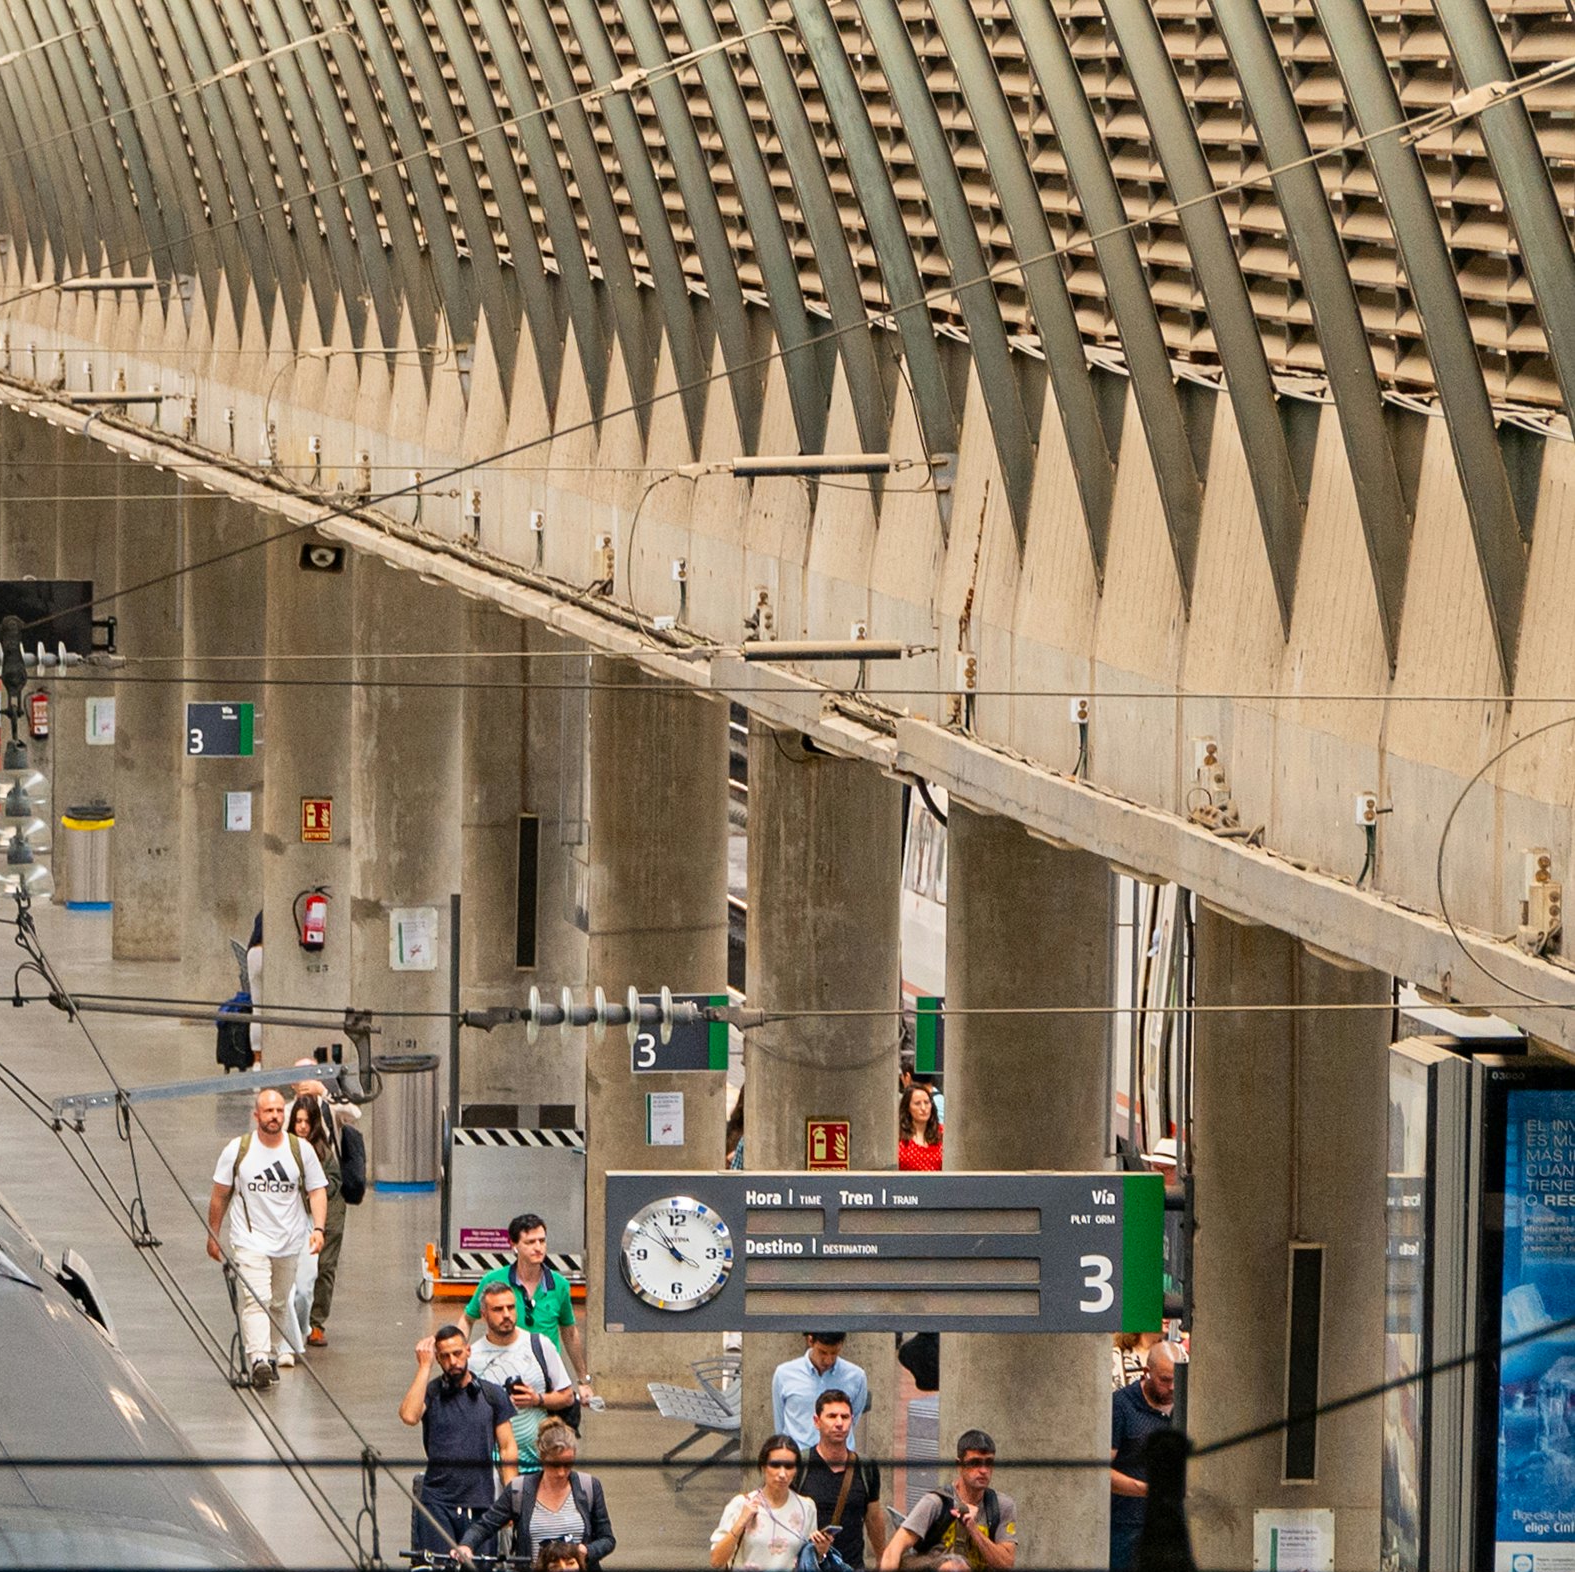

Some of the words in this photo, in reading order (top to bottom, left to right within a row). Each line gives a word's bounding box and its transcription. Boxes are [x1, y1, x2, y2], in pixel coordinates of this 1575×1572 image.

[189, 728, 204, 754] 3
[637, 1033, 657, 1068] 3
[1526, 1120, 1547, 1132] EL
[1526, 1134, 1548, 1147] ES
[247, 1180, 295, 1193] adidas
[745, 1190, 782, 1205] Hora
[799, 1195, 822, 1205] TIME
[839, 1190, 873, 1205] Tren
[892, 1195, 918, 1205] TRAIN
[1091, 1188, 1116, 1205] Vía
[668, 1214, 686, 1227] 12
[745, 1239, 803, 1254] Destino
[823, 1244, 878, 1254] DESTINATION
[636, 1249, 647, 1261] 9
[705, 1248, 717, 1260] 3
[671, 1282, 683, 1294] 6
[1079, 1254, 1115, 1313] 3
[1525, 1522, 1550, 1535] elige
